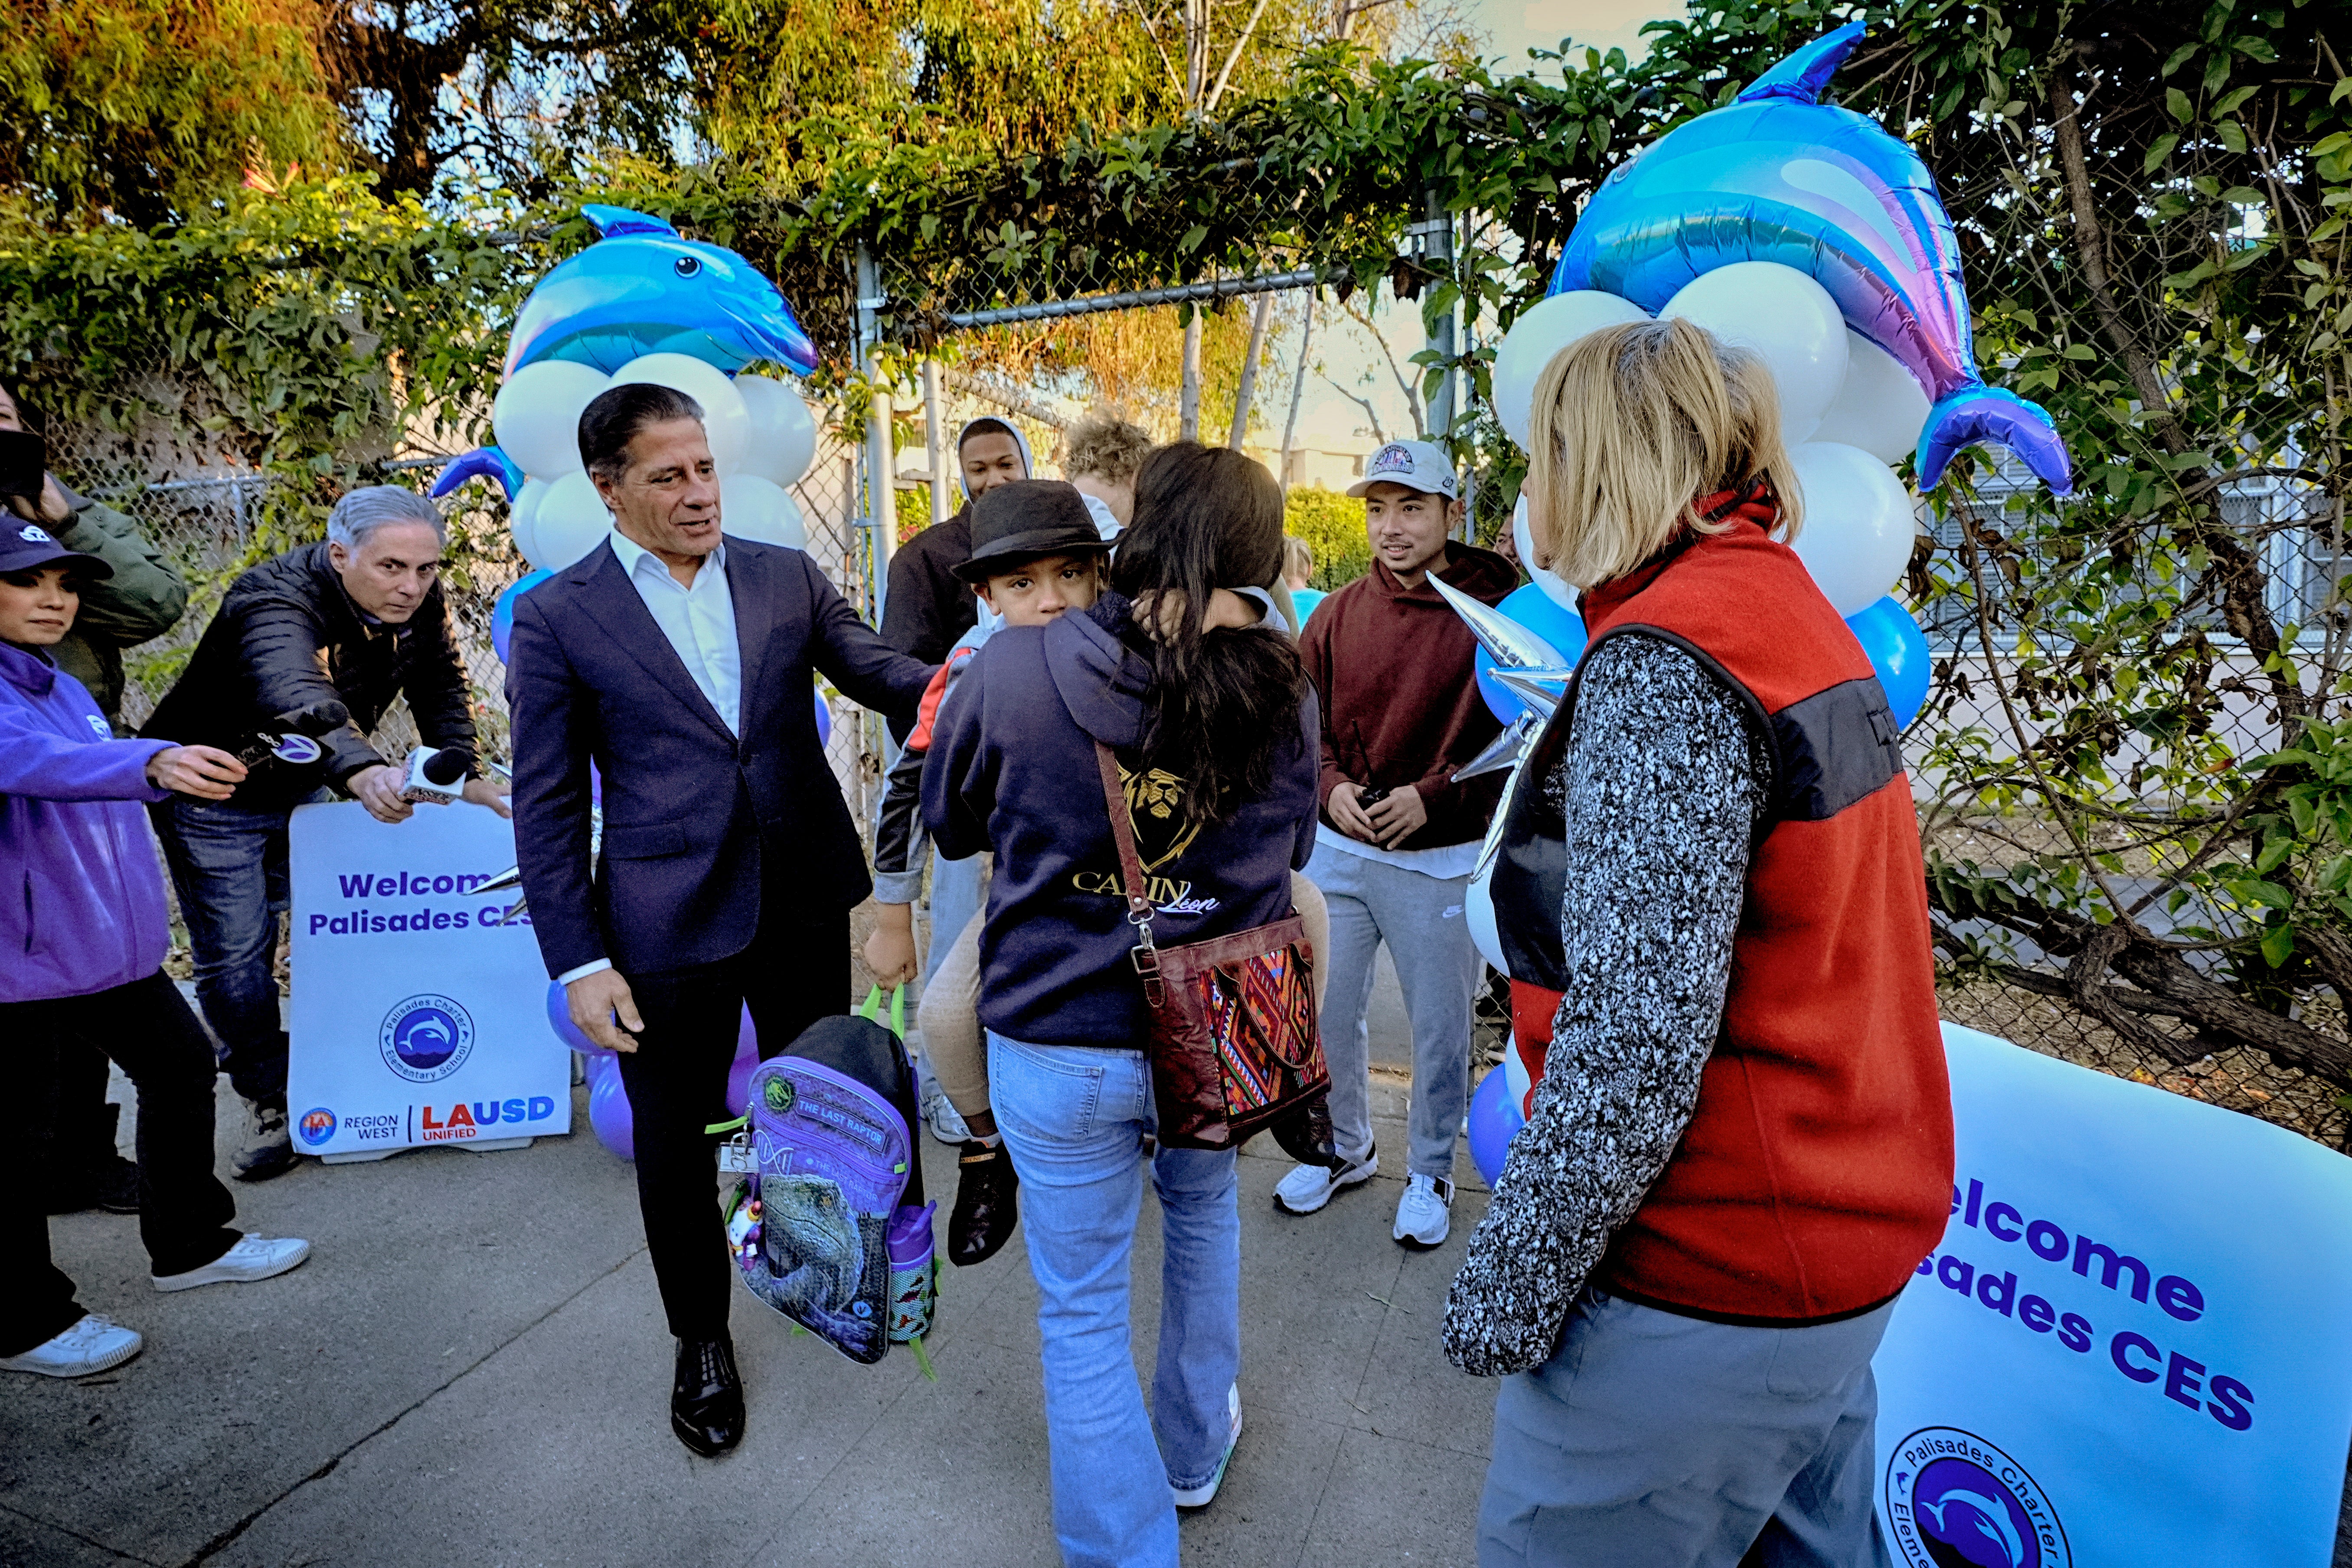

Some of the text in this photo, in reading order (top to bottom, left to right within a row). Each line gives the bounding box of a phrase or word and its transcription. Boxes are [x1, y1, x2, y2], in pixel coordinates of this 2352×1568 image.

[339, 871, 491, 898] Welcom
[1073, 871, 1188, 907] CAIN
[309, 905, 469, 935] Palisades
[434, 999, 467, 1027] Charter
[386, 1045, 467, 1080] Elementary School
[345, 1114, 399, 1128] REGION
[358, 1127, 398, 1140] WEST
[423, 1128, 476, 1141] UNIFIED
[799, 1100, 882, 1146] THE LAST RAPTOR
[1950, 1177, 2205, 1322] lcome
[1914, 1252, 2255, 1432] sades CES
[1904, 1437, 2059, 1561] Palisades Charter
[1894, 1503, 1930, 1568] Eleme
